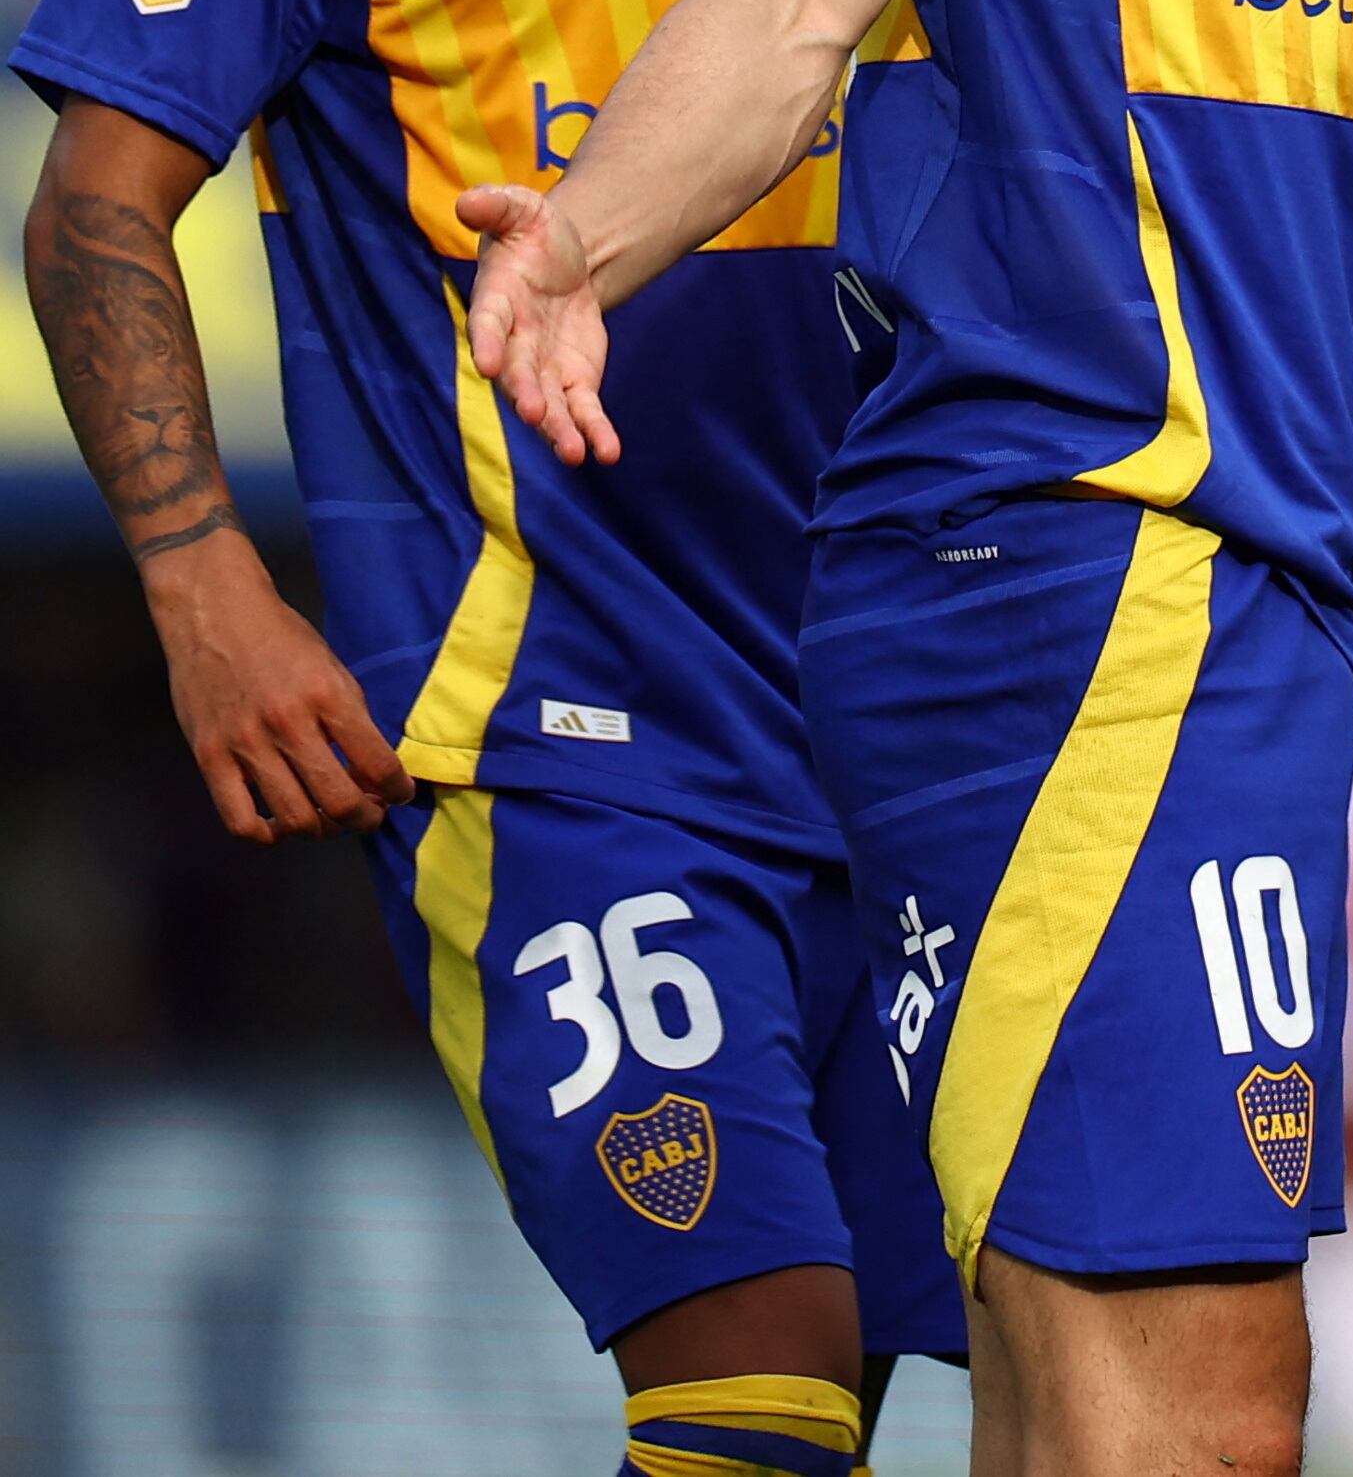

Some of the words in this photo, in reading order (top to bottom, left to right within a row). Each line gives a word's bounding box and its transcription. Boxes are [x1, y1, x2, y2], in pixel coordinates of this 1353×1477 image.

[935, 545, 998, 563] AEROREADY
[513, 891, 724, 1118] 36
[887, 895, 956, 1107] ax
[1190, 855, 1315, 1055] 10
[620, 1132, 705, 1184] CABJ
[1254, 1112, 1307, 1142] CABJ
